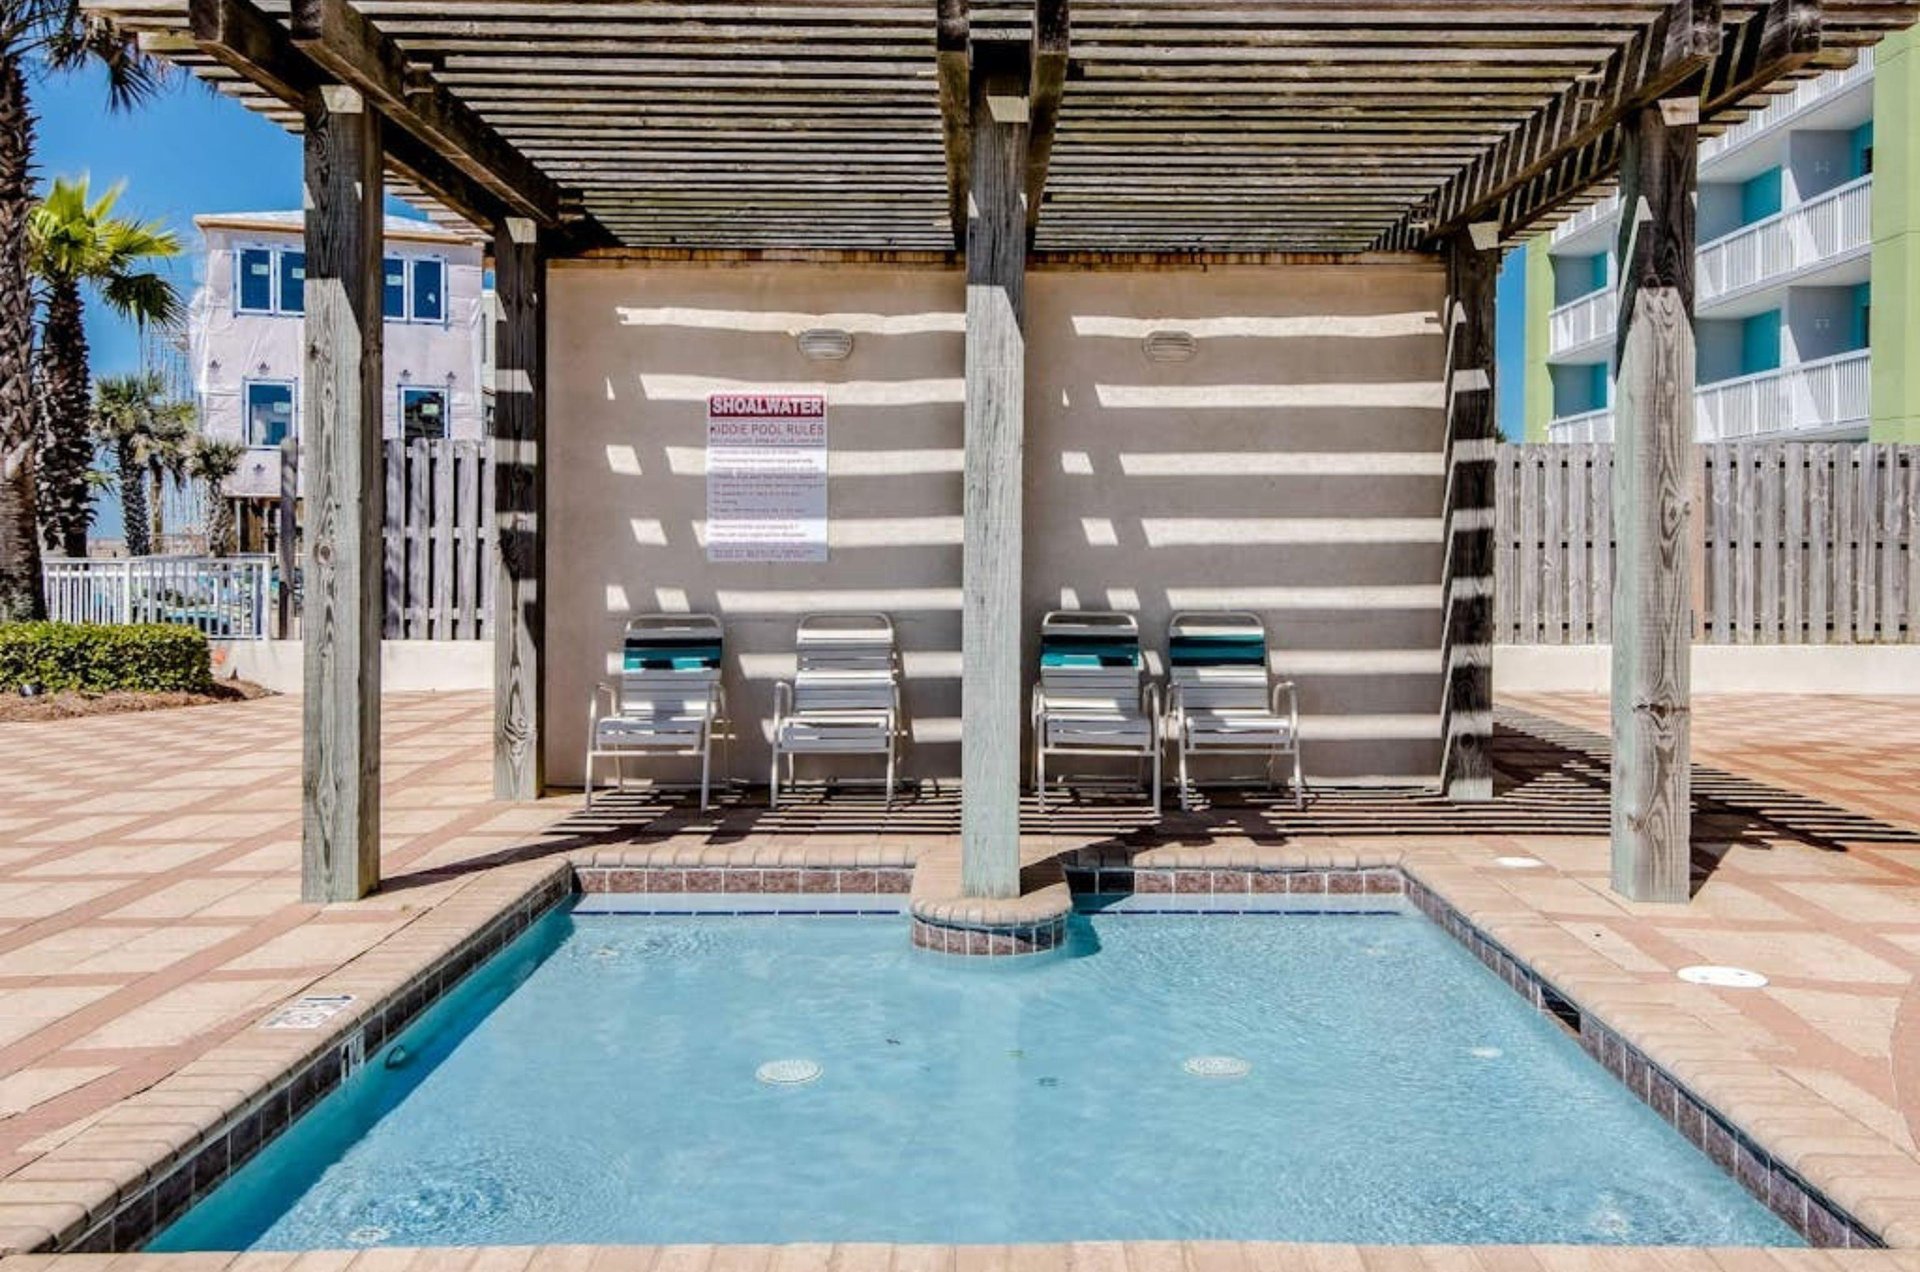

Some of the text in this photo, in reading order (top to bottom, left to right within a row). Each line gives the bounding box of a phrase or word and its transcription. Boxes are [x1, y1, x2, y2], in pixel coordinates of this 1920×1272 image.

[711, 397, 822, 414] SHOALWATER
[751, 423, 783, 435] POOL
[787, 423, 824, 435] RULES
